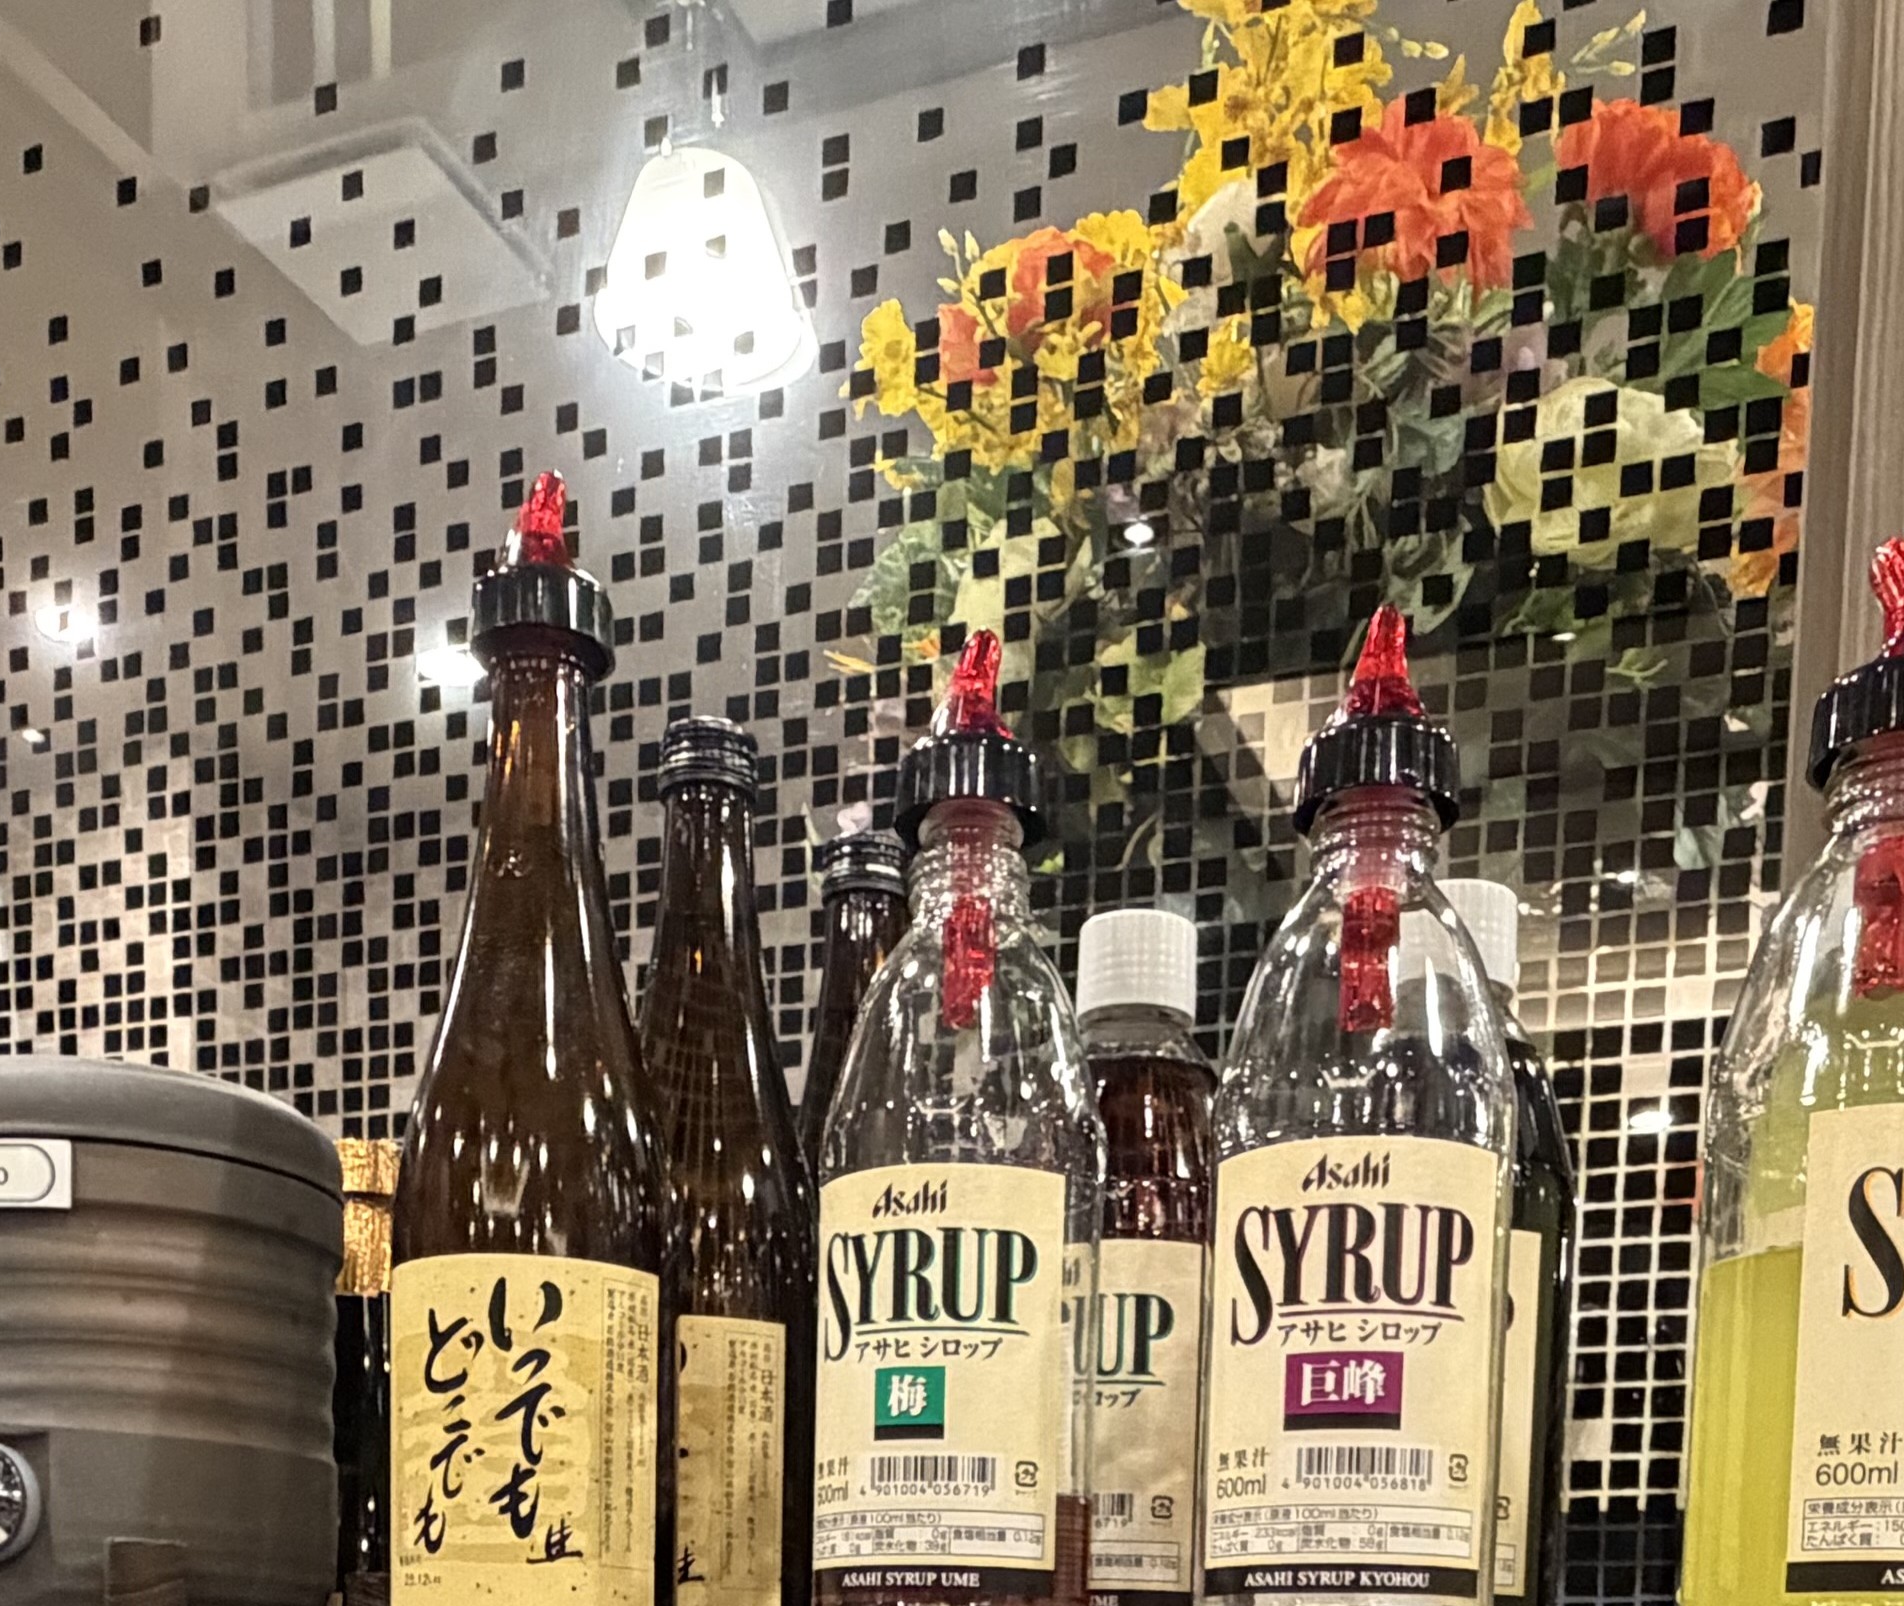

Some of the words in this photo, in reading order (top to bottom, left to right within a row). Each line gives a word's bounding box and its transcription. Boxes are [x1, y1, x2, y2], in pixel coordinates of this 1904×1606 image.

[1302, 1151, 1391, 1193] Asahi
[871, 1178, 948, 1219] Asahi
[1231, 1201, 1475, 1347] SYRUP
[824, 1226, 1038, 1363] SYRUP
[1277, 1320, 1346, 1347] アサヒ
[1358, 1319, 1443, 1346] シロップ
[853, 1337, 911, 1363] アサヒ
[920, 1336, 1005, 1361] シロップ
[886, 1373, 928, 1418] 梅
[1299, 1358, 1387, 1407] 巨峰
[488, 1275, 567, 1539] いつでも
[1817, 1431, 1904, 1457] 無果汁
[1302, 1476, 1363, 1490] 901004
[1815, 1460, 1899, 1487] 600ml
[875, 1484, 927, 1496] 901004
[1217, 1475, 1267, 1500] 600ml
[842, 1572, 882, 1588] ASAHI
[885, 1571, 937, 1587] SYRUP
[941, 1572, 981, 1588] UME
[1244, 1570, 1293, 1587] ASAHI
[1296, 1571, 1356, 1587] SYRUP
[1359, 1572, 1431, 1588] KYOHOU
